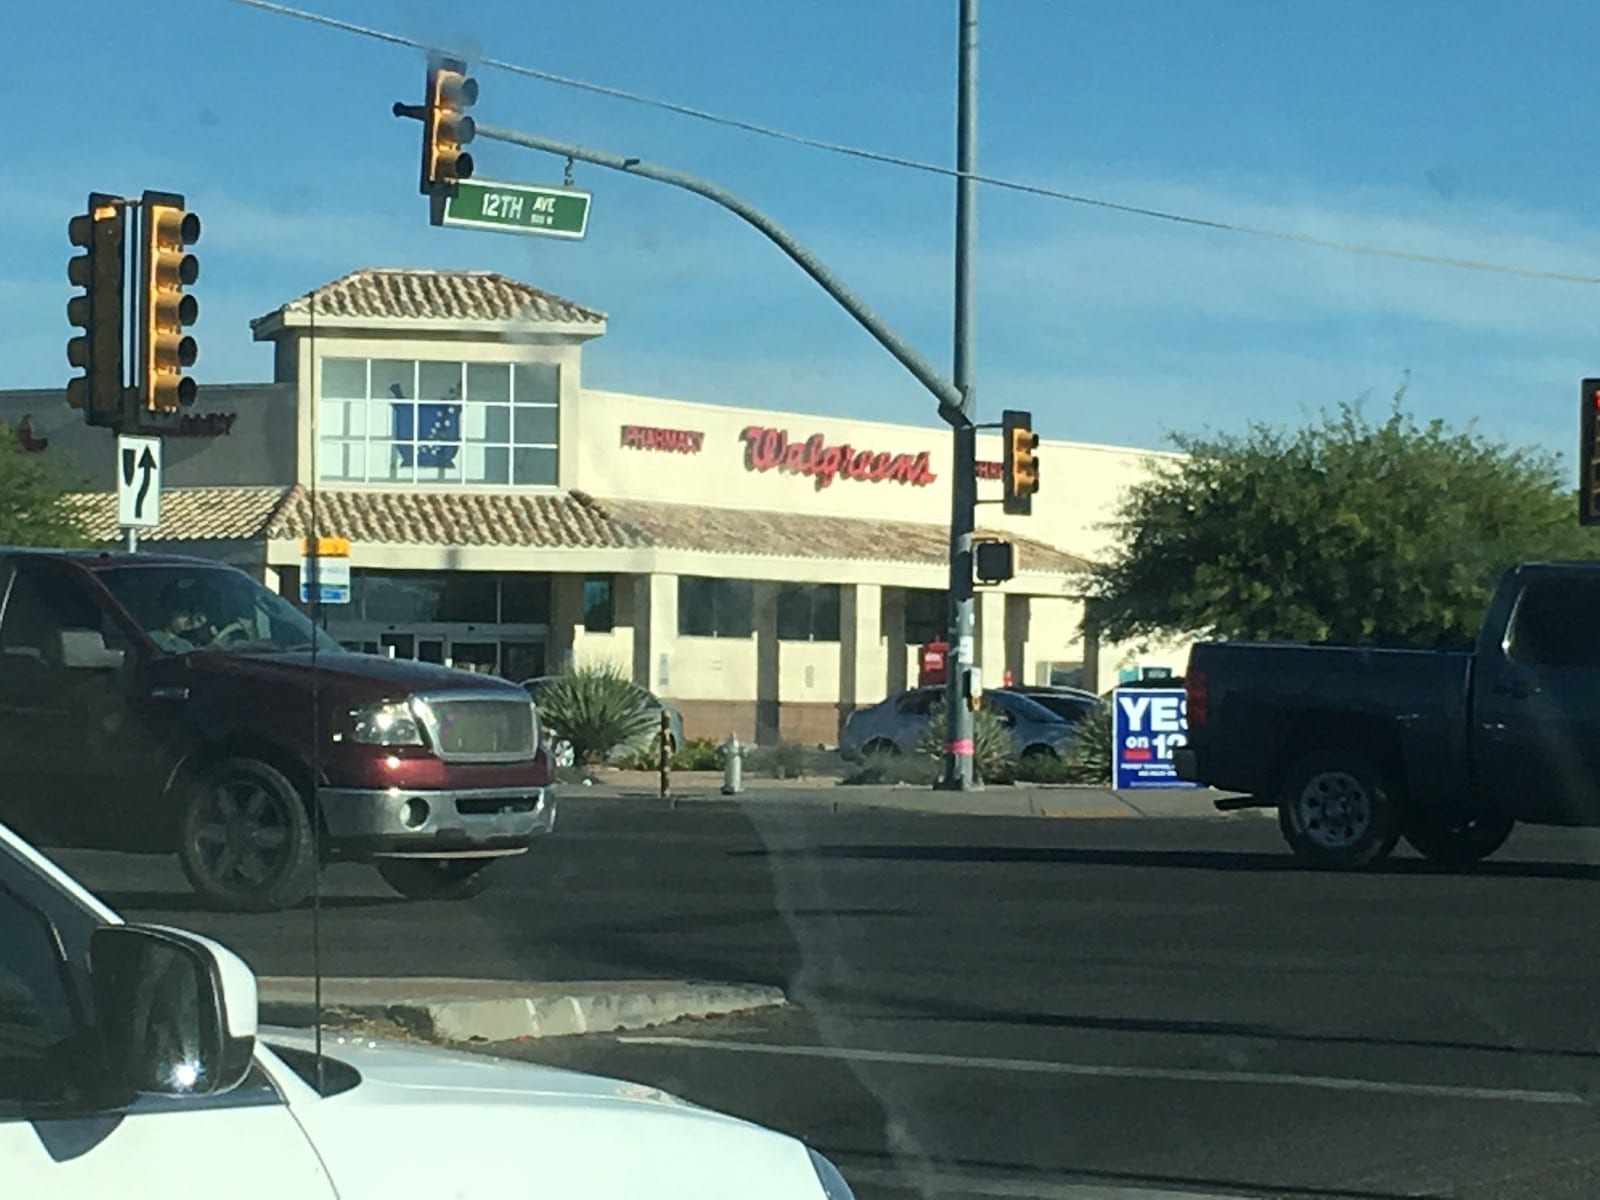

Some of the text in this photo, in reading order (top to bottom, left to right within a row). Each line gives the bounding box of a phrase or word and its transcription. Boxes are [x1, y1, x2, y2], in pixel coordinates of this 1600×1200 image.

[482, 193, 524, 219] 12TH
[532, 196, 556, 213] AVE
[620, 425, 704, 455] PHARMACY
[738, 426, 938, 492] Walgreens
[1118, 696, 1188, 731] YE
[1125, 736, 1149, 749] on
